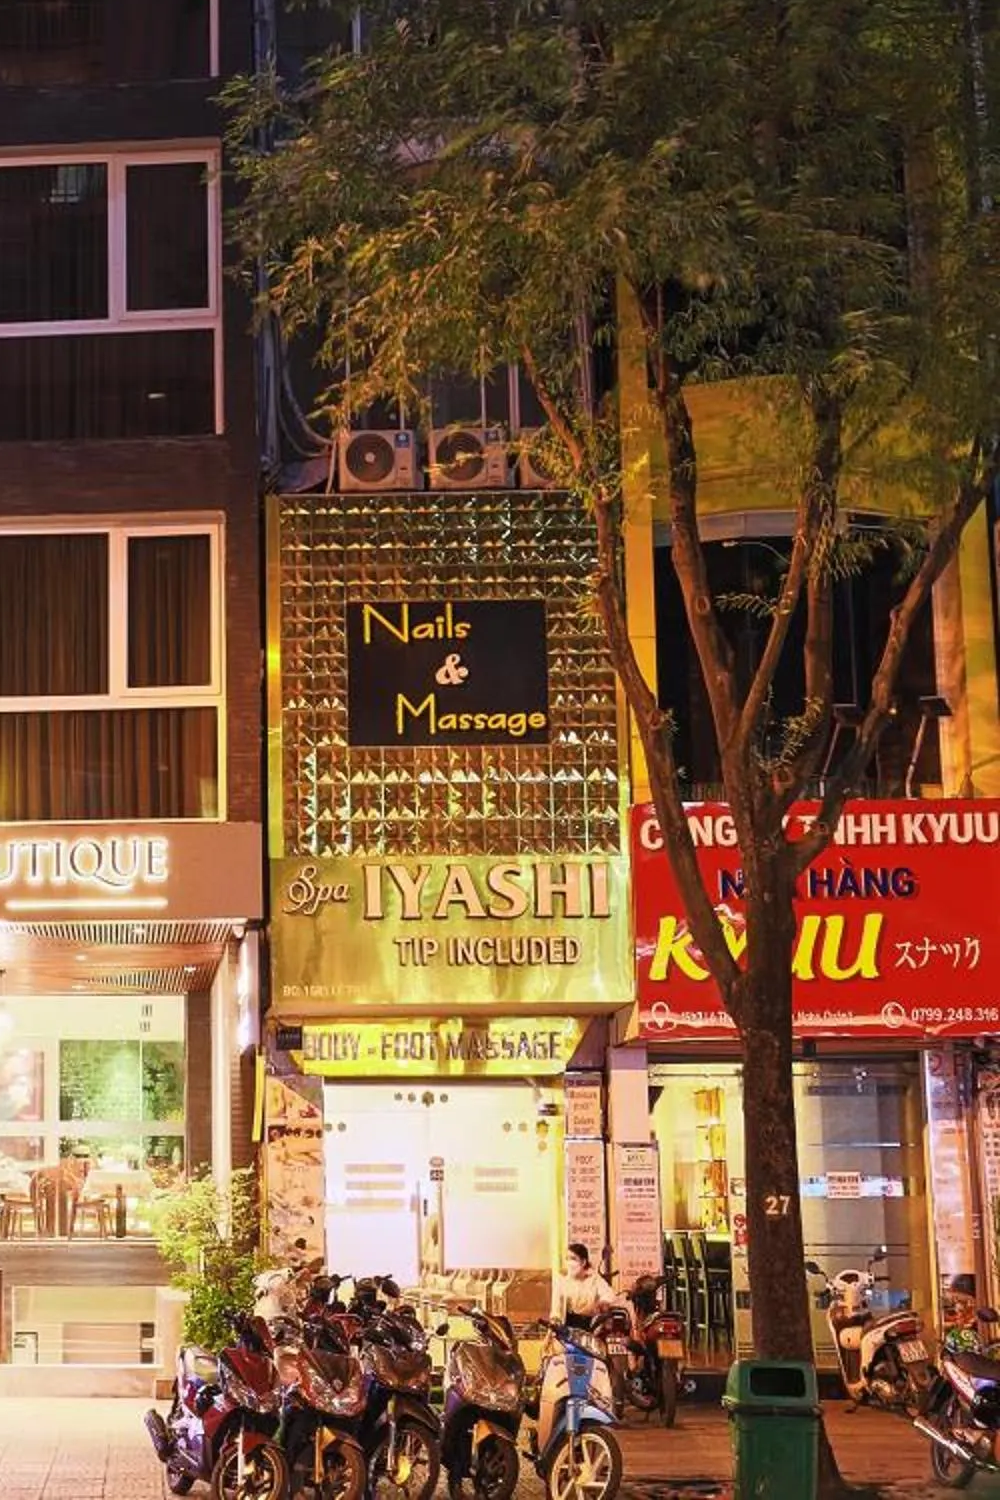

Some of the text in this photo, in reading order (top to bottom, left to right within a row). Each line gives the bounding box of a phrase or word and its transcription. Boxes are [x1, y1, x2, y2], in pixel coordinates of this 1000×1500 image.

[362, 601, 472, 644] Nails
[435, 653, 470, 685] &
[396, 692, 547, 737] Massage
[640, 813, 738, 850] CNG
[902, 812, 999, 843] KYUU
[283, 865, 350, 916] Spa
[362, 861, 611, 921] IYASHI
[809, 858, 916, 897] HÀNG
[393, 935, 583, 967] TIP INCLUDED
[895, 937, 980, 969] スナック
[302, 1033, 360, 1061] BODY
[380, 1032, 437, 1061] FOOT
[445, 1032, 562, 1061] MASSAGE
[765, 1195, 791, 1216] 27
